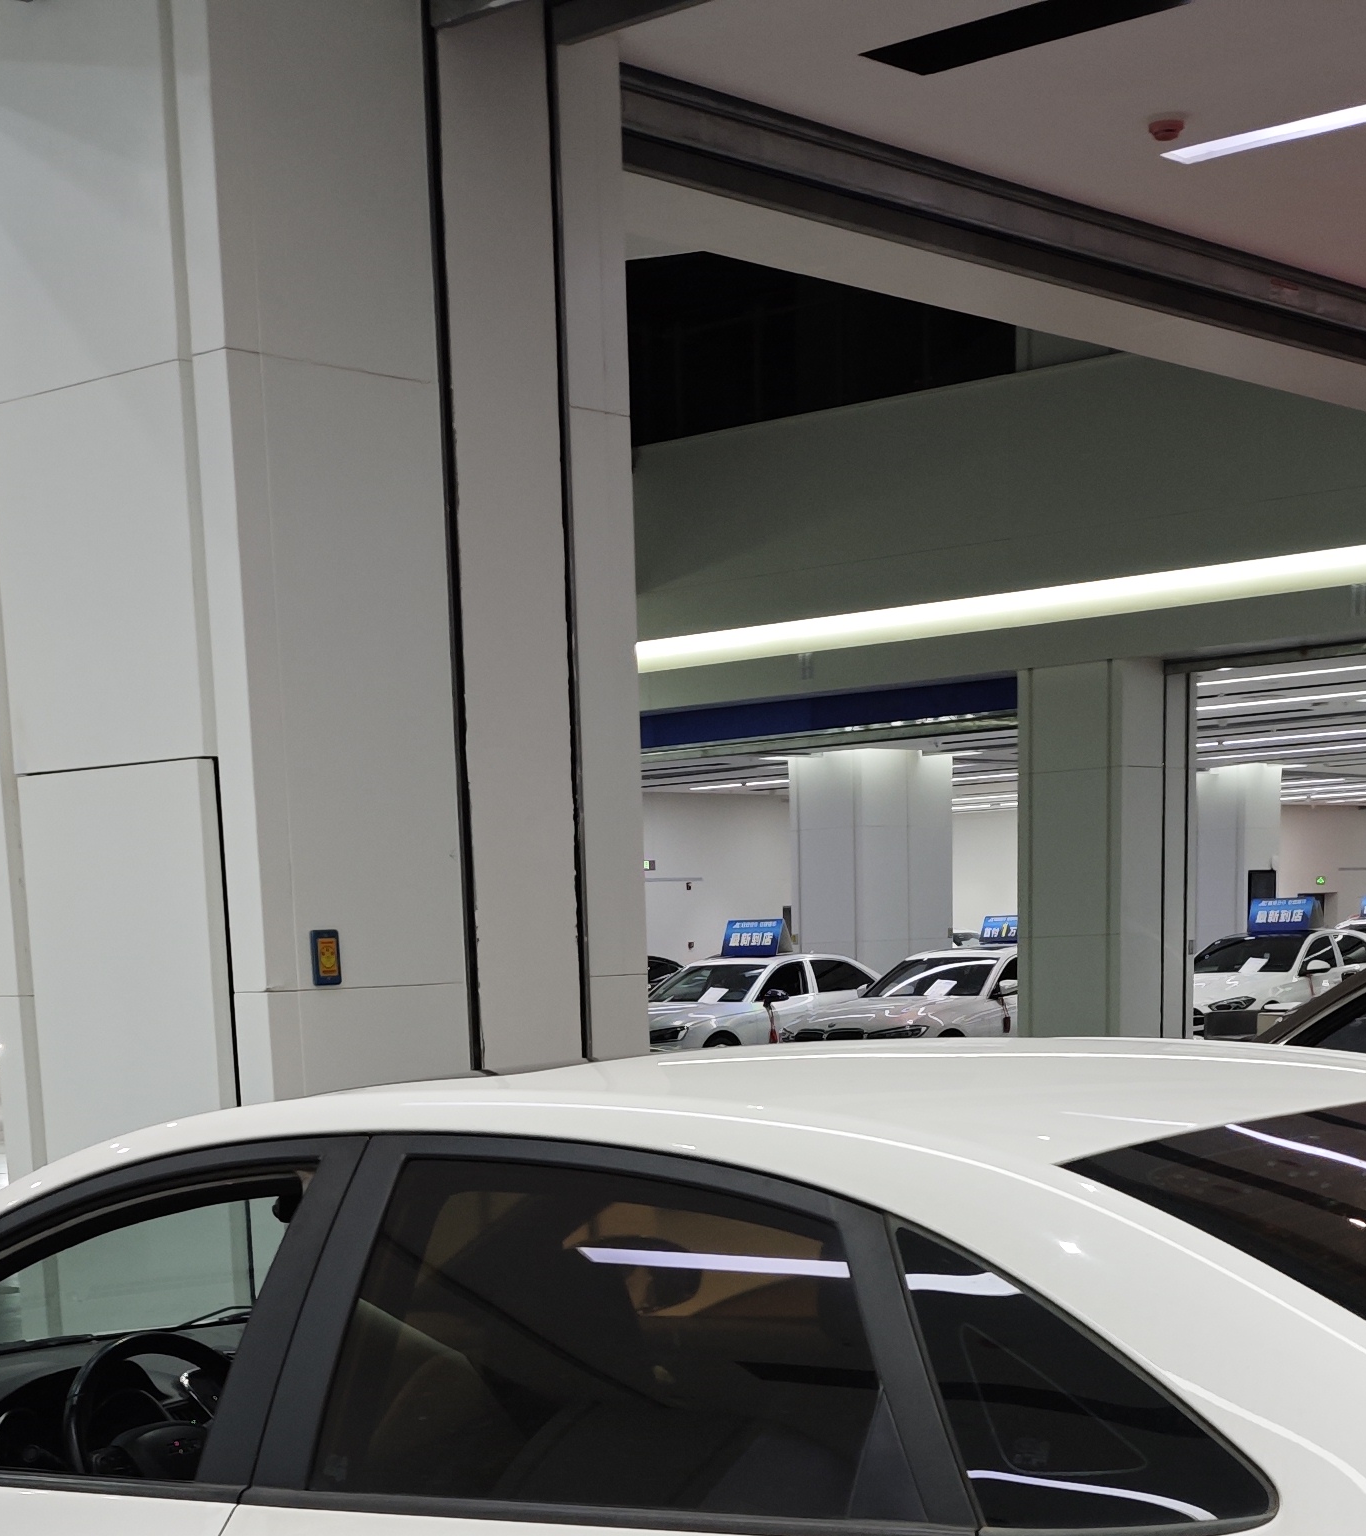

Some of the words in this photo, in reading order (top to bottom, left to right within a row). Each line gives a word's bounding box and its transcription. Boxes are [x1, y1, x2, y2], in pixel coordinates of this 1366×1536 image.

[1255, 909, 1304, 923] 最新到店
[983, 923, 1017, 938] 首付1万
[729, 932, 773, 947] 最新到店
